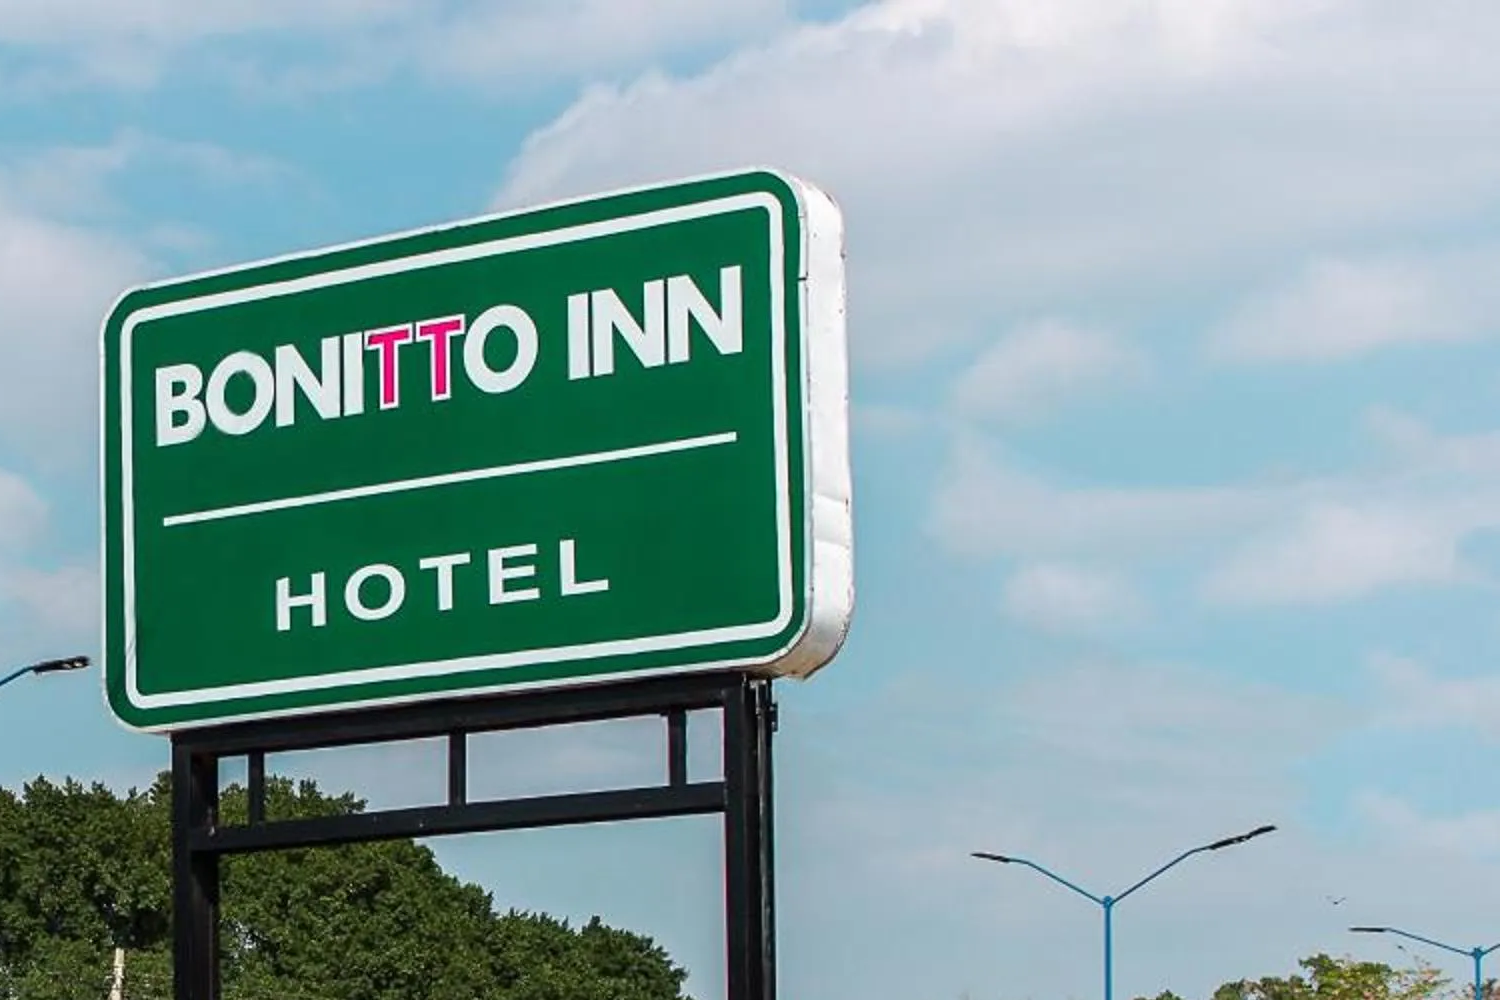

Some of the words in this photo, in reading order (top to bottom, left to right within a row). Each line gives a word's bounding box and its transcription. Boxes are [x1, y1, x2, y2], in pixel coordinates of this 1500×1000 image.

[154, 304, 539, 447] BONITTO
[567, 265, 743, 381] INN
[275, 539, 610, 632] HOTEL
